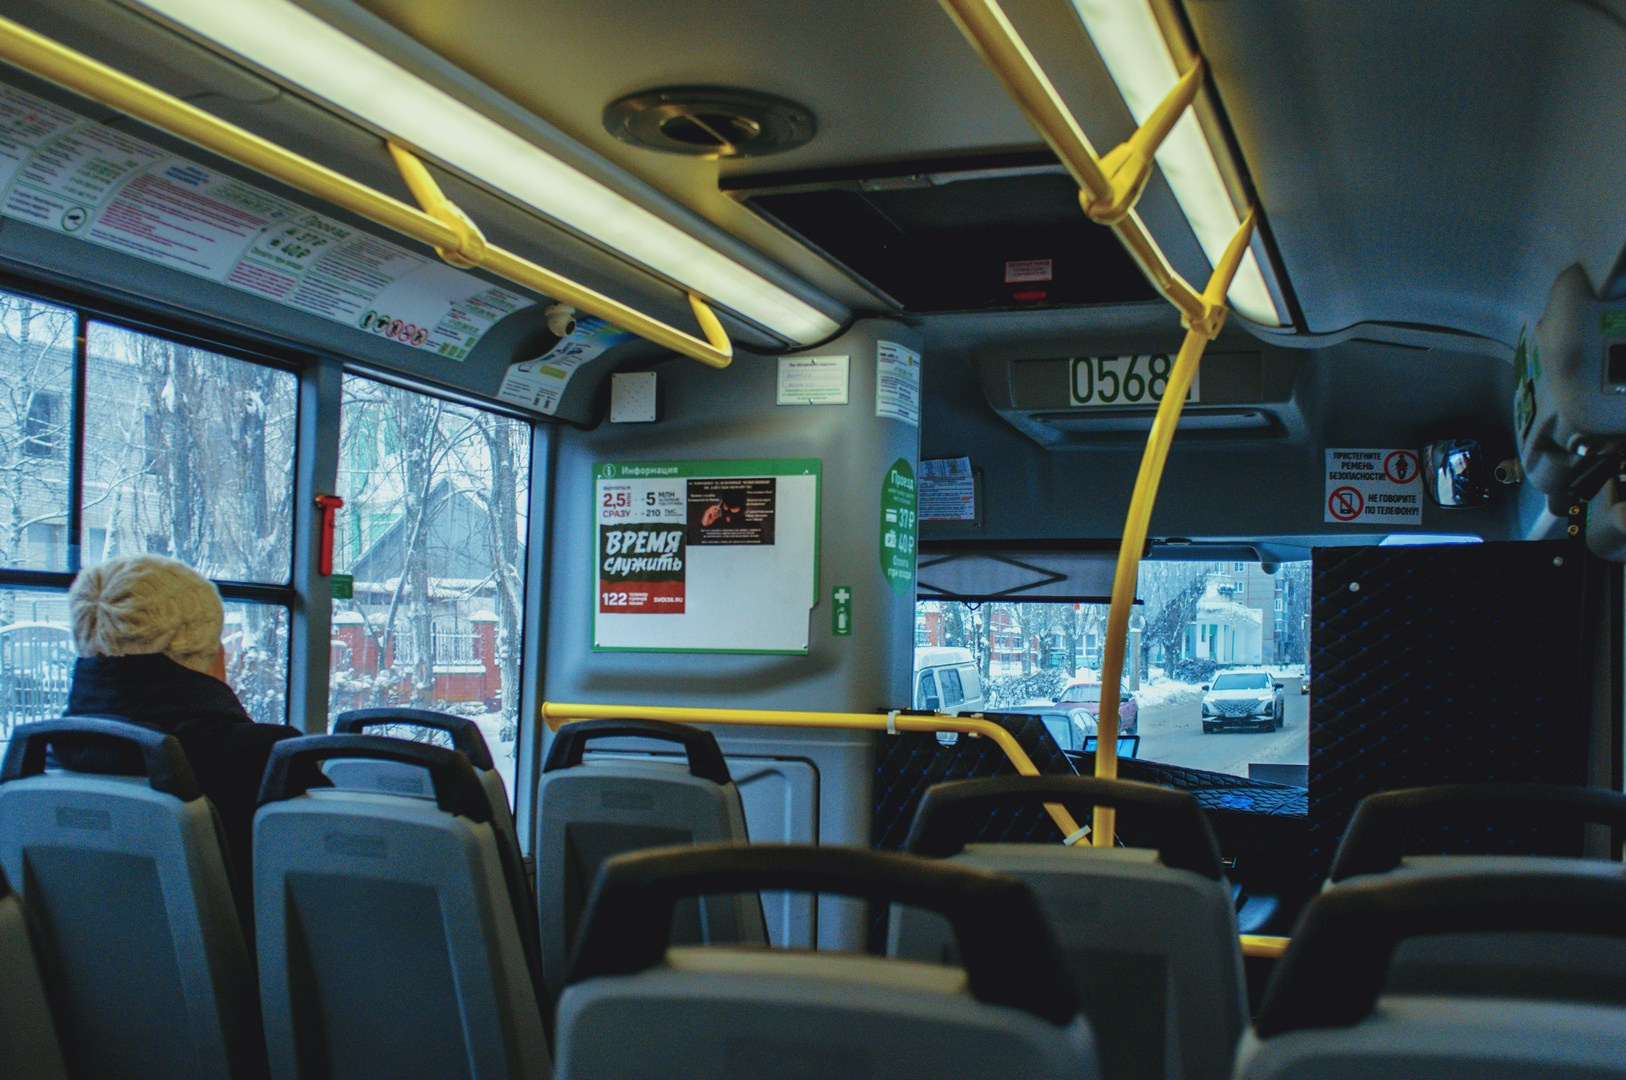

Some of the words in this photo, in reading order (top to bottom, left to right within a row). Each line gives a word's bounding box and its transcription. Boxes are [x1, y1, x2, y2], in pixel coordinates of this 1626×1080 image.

[1333, 452, 1381, 460] ПРИСТЕГНИТЕ
[621, 466, 678, 476] Информация
[1341, 462, 1374, 470] РЕМЕНЬ
[891, 470, 914, 492] Проезд
[603, 493, 626, 509] 2,5
[646, 492, 656, 506] 5
[1368, 494, 1378, 502] НЕ
[1380, 494, 1416, 503] ГОВОРИТЕ
[603, 510, 631, 518] СРАЗУ
[646, 509, 661, 517] 210
[1365, 506, 1375, 514] ПО
[1377, 506, 1419, 516] ТЕЛЕФОНУ!
[605, 531, 682, 555] ВРЕМЯ
[603, 552, 682, 577] служить
[602, 592, 627, 606] 122
